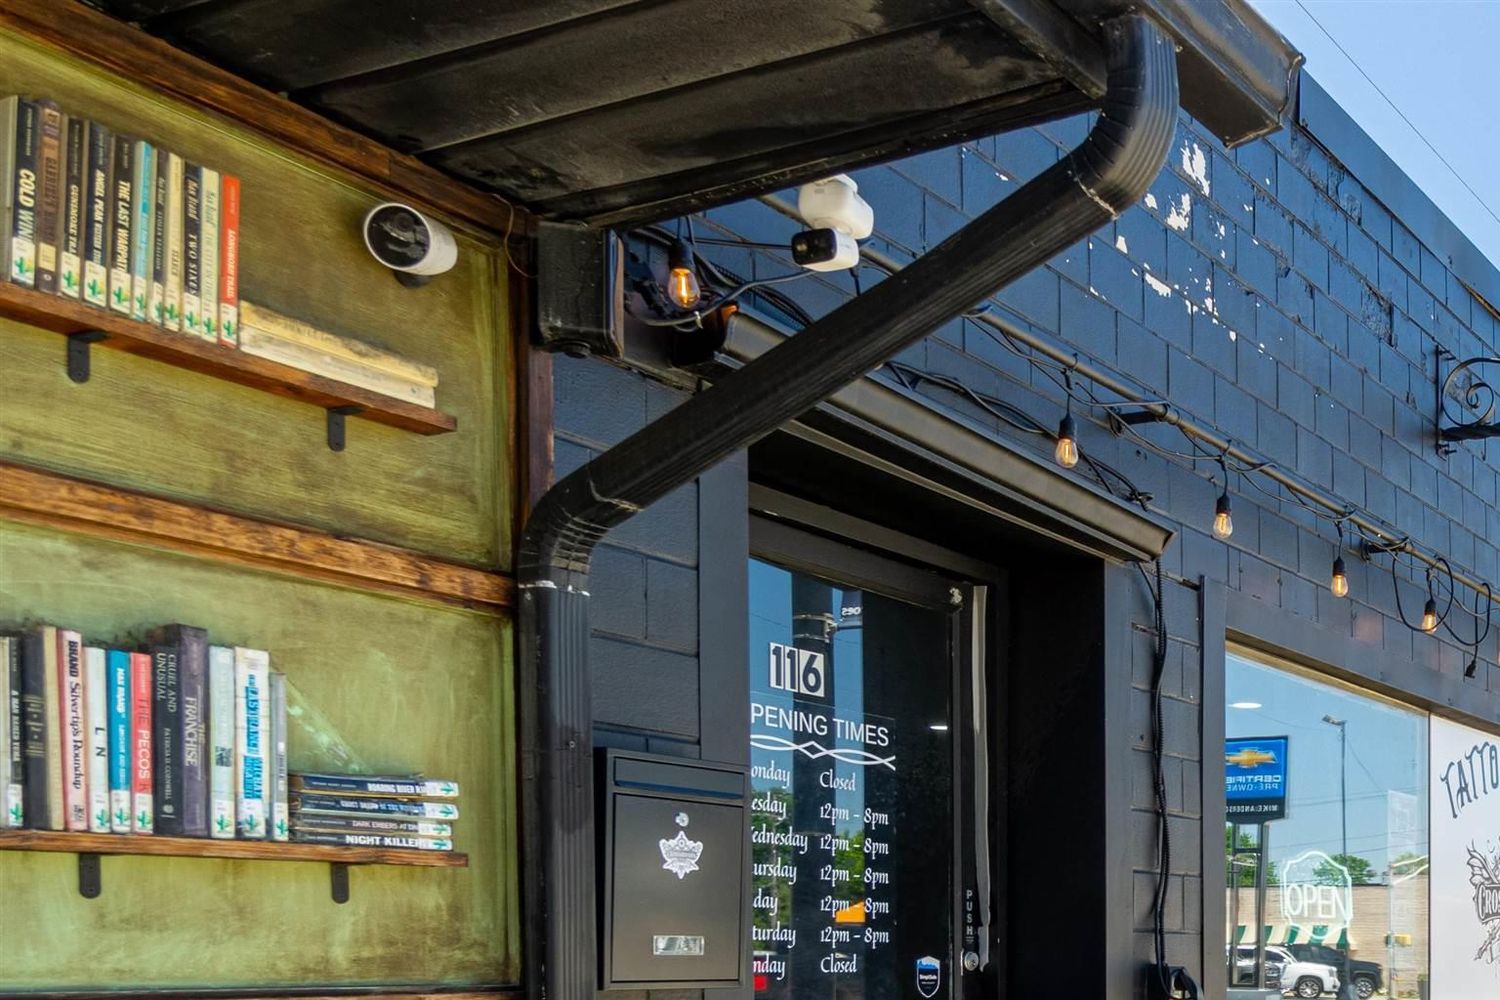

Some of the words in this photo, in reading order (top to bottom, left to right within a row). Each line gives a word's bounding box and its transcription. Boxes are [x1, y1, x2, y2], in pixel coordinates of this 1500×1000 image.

[18, 169, 34, 207] COLD
[95, 170, 104, 196] ANGEL
[119, 181, 130, 199] THE
[94, 201, 104, 222] PEAK
[118, 201, 128, 225] LAST
[68, 237, 77, 256] TRA
[189, 234, 197, 259] TWO
[68, 640, 78, 677] BRAND
[168, 654, 176, 687] CRUEL
[771, 643, 823, 695] 116
[157, 653, 166, 700] UNUSUAL
[168, 690, 176, 712] AND
[185, 697, 197, 766] FRANCHISE
[751, 704, 827, 735] PENING
[833, 718, 889, 746] TIMES
[138, 729, 150, 779] PECOS
[751, 760, 790, 788] onday
[820, 769, 856, 791] Closed
[751, 792, 786, 820] esday
[820, 803, 849, 825] 12pm
[864, 808, 889, 829] 8pm
[346, 835, 380, 845] NIGHT
[751, 824, 808, 854] ednesday
[820, 834, 849, 856] 12pm
[864, 838, 889, 859] 8pm
[753, 857, 796, 885] ursday
[820, 865, 849, 887] 12pm
[864, 868, 889, 889] 8pm
[754, 888, 778, 916] day
[820, 896, 849, 918] 12pm
[864, 898, 889, 919] 8pm
[1287, 883, 1347, 920] OPEN
[752, 922, 796, 948] turday
[820, 926, 849, 948] 12pm
[864, 927, 889, 948] 8pm
[753, 956, 785, 980] nday
[820, 953, 857, 973] Closed
